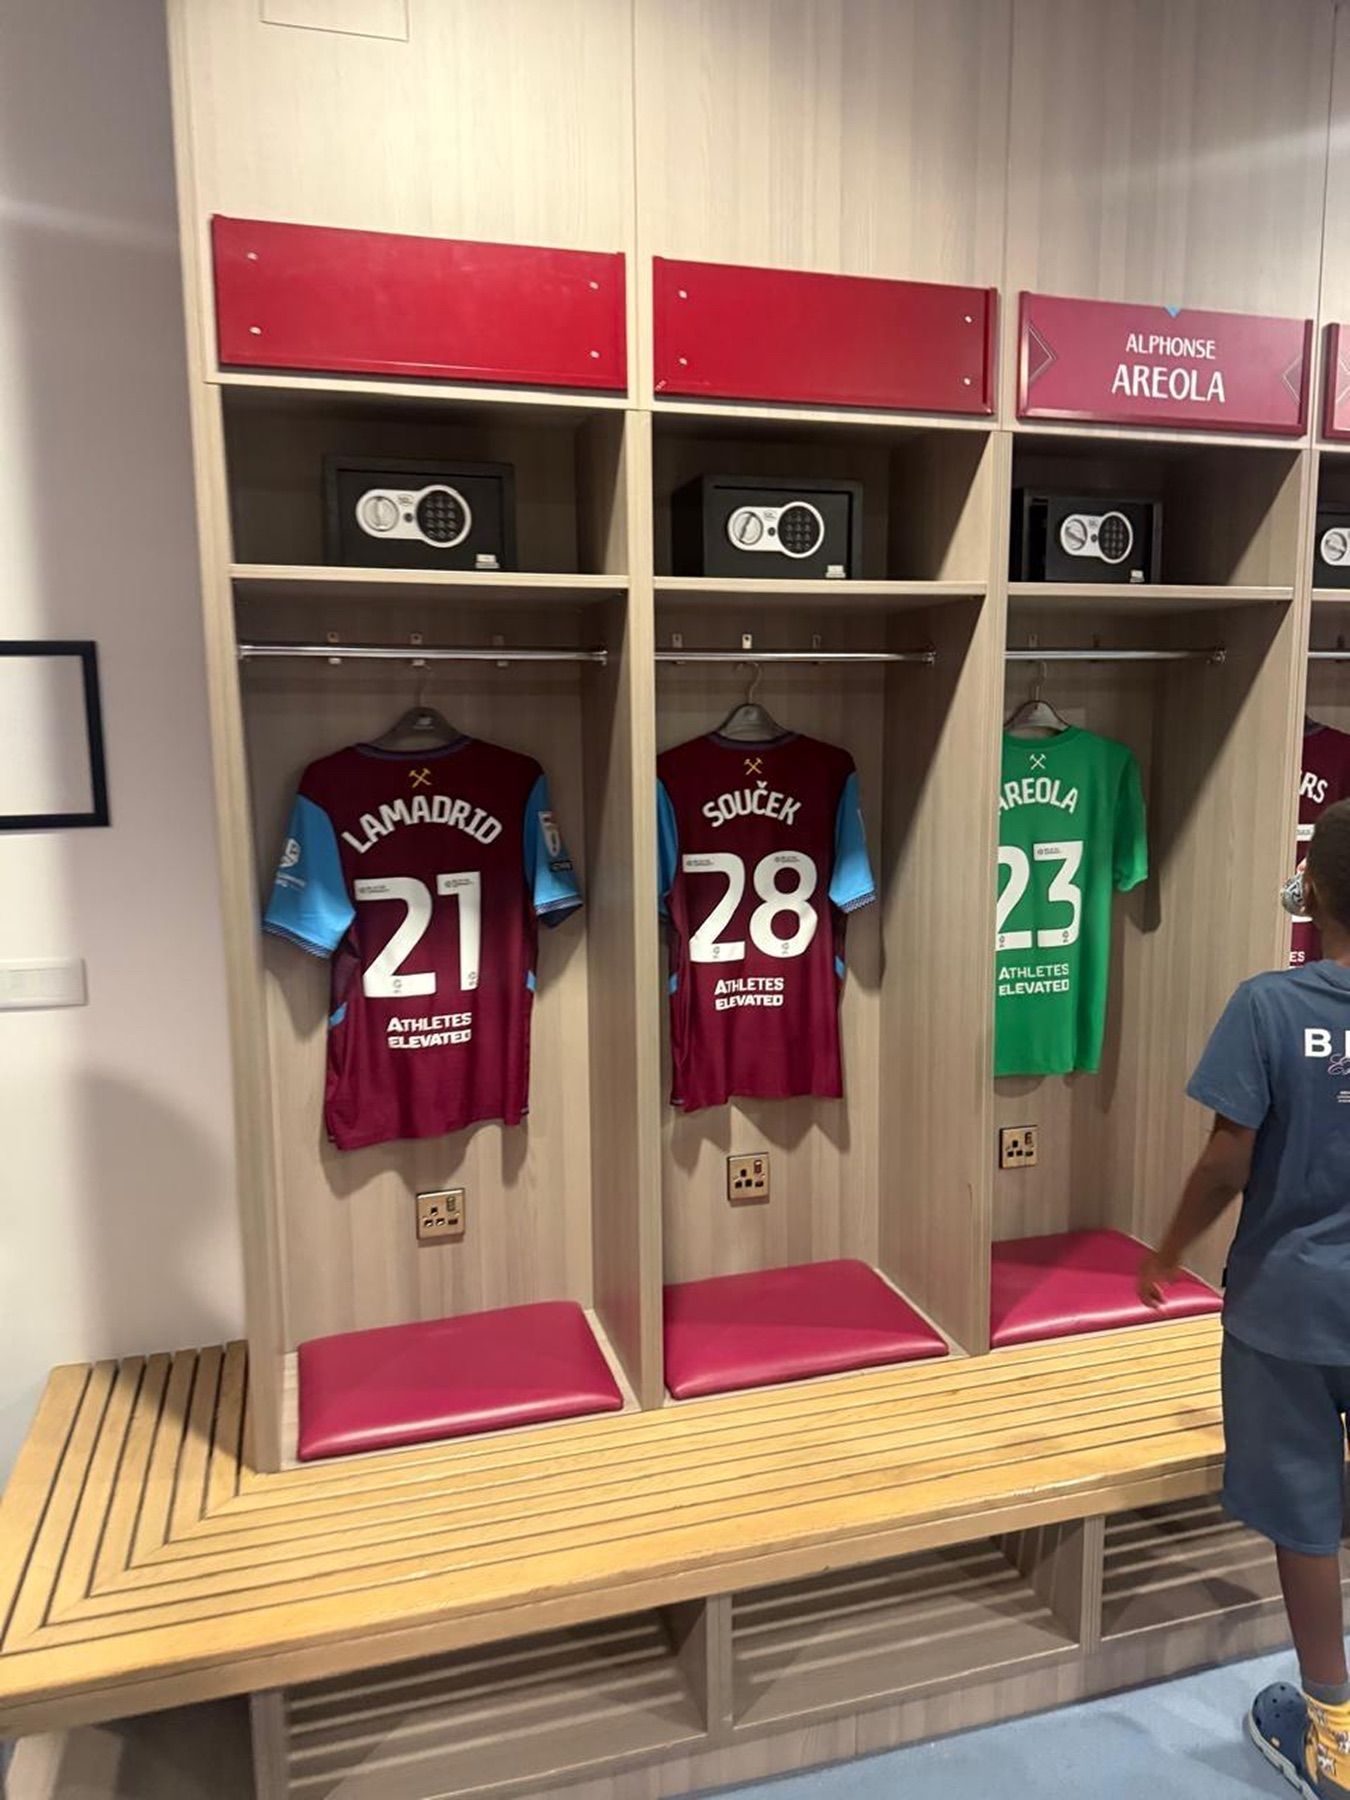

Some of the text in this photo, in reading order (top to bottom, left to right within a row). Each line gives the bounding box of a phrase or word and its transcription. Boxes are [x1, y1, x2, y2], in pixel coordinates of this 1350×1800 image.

[1126, 333, 1216, 360] ALPHONSE
[1111, 364, 1225, 403] AREOLA
[702, 781, 801, 828] SOUČEK
[341, 795, 502, 854] LAMADRID
[683, 850, 818, 963] 28
[355, 871, 481, 998] 21
[998, 963, 1070, 981] ATHLETES
[715, 977, 784, 995] ATHLETES
[998, 979, 1070, 996] ELEVATED
[715, 994, 784, 1011] ELEVATED
[387, 1012, 472, 1032] ATHLETES
[388, 1029, 472, 1049] ELEVATED
